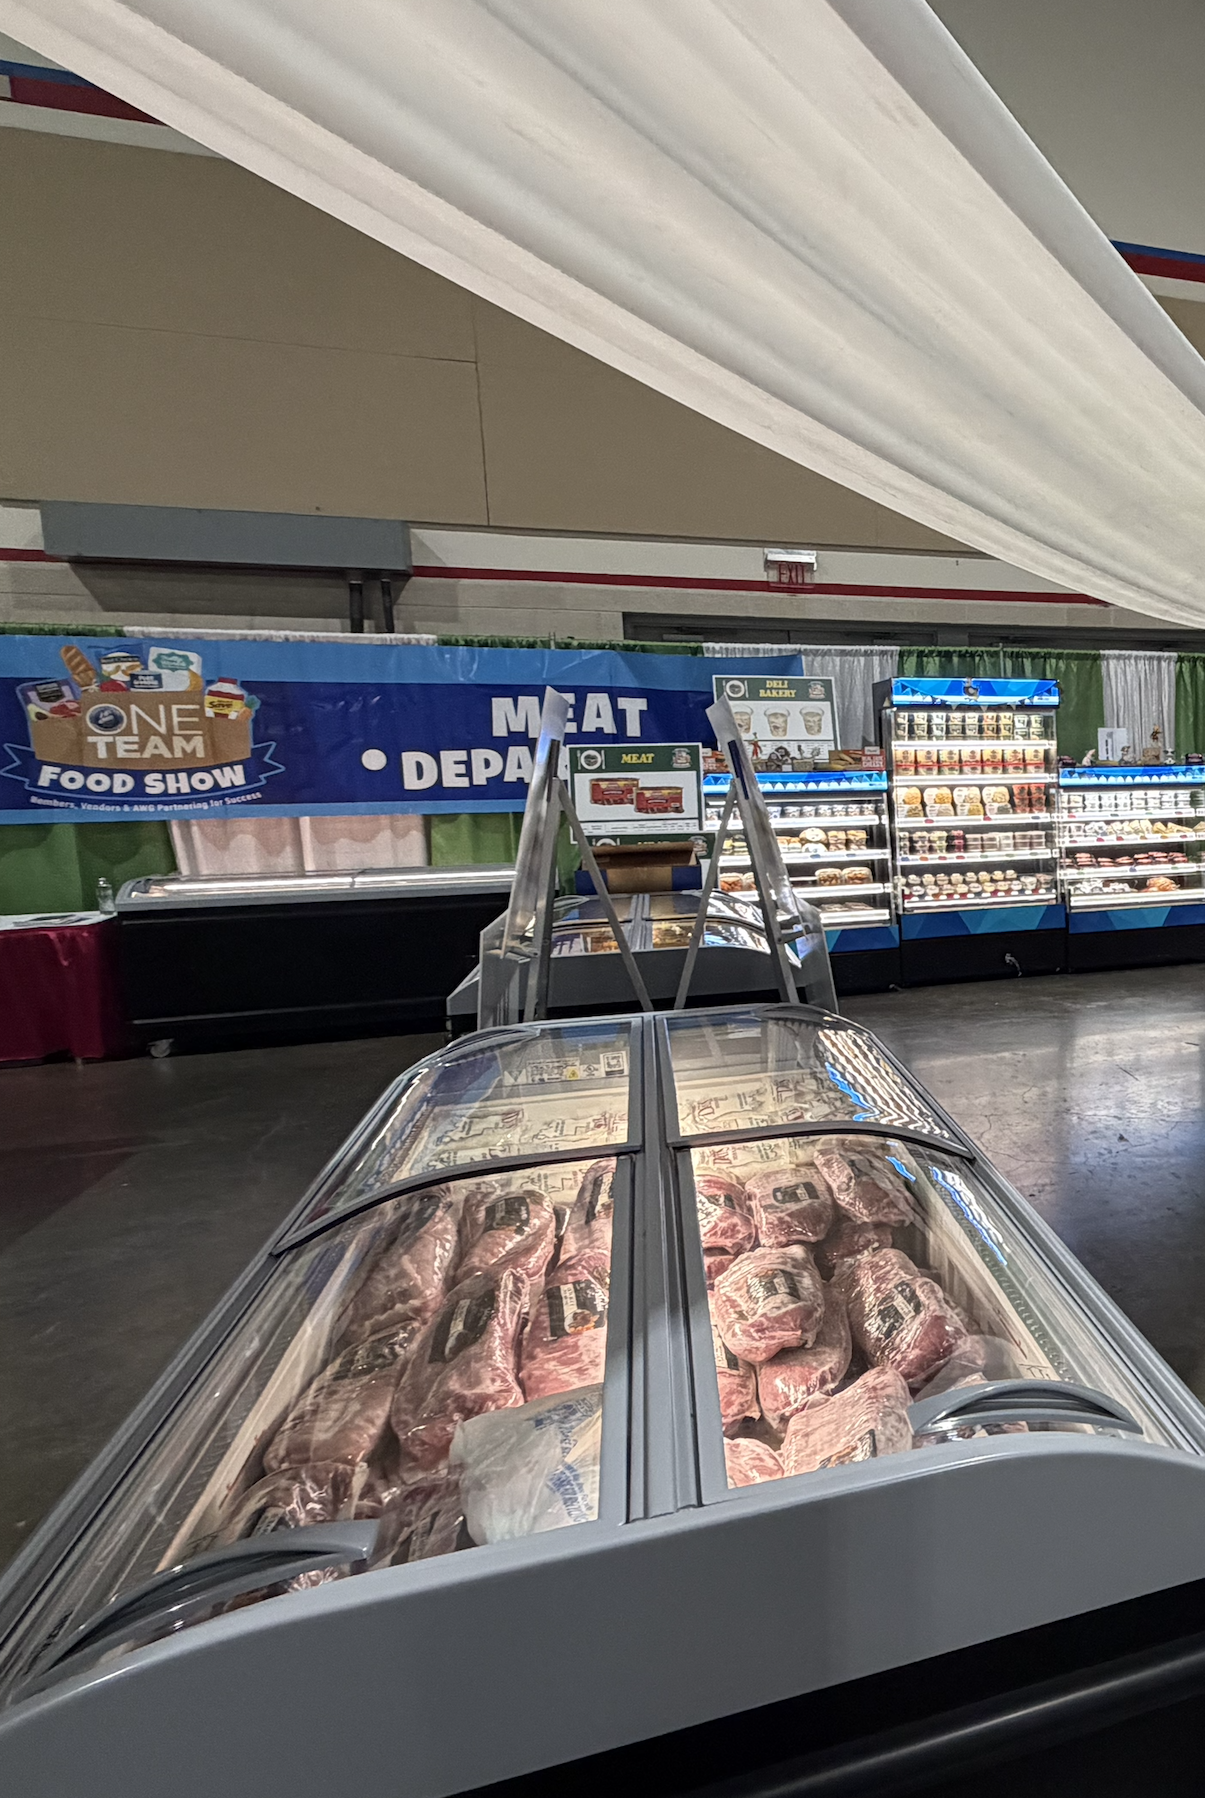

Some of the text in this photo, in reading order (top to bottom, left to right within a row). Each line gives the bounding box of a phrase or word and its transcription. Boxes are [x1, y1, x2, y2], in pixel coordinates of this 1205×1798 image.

[759, 689, 797, 698] BAKERY
[766, 680, 789, 688] DELI
[86, 703, 204, 736] ONE
[87, 736, 205, 759] TEAM
[620, 753, 655, 763] MEAT
[37, 764, 246, 795] FOOD SHOW
[80, 801, 121, 812] Vendors
[122, 803, 131, 812] &
[157, 800, 209, 811] Partnering
[209, 798, 223, 807] for
[224, 791, 262, 805] Success
